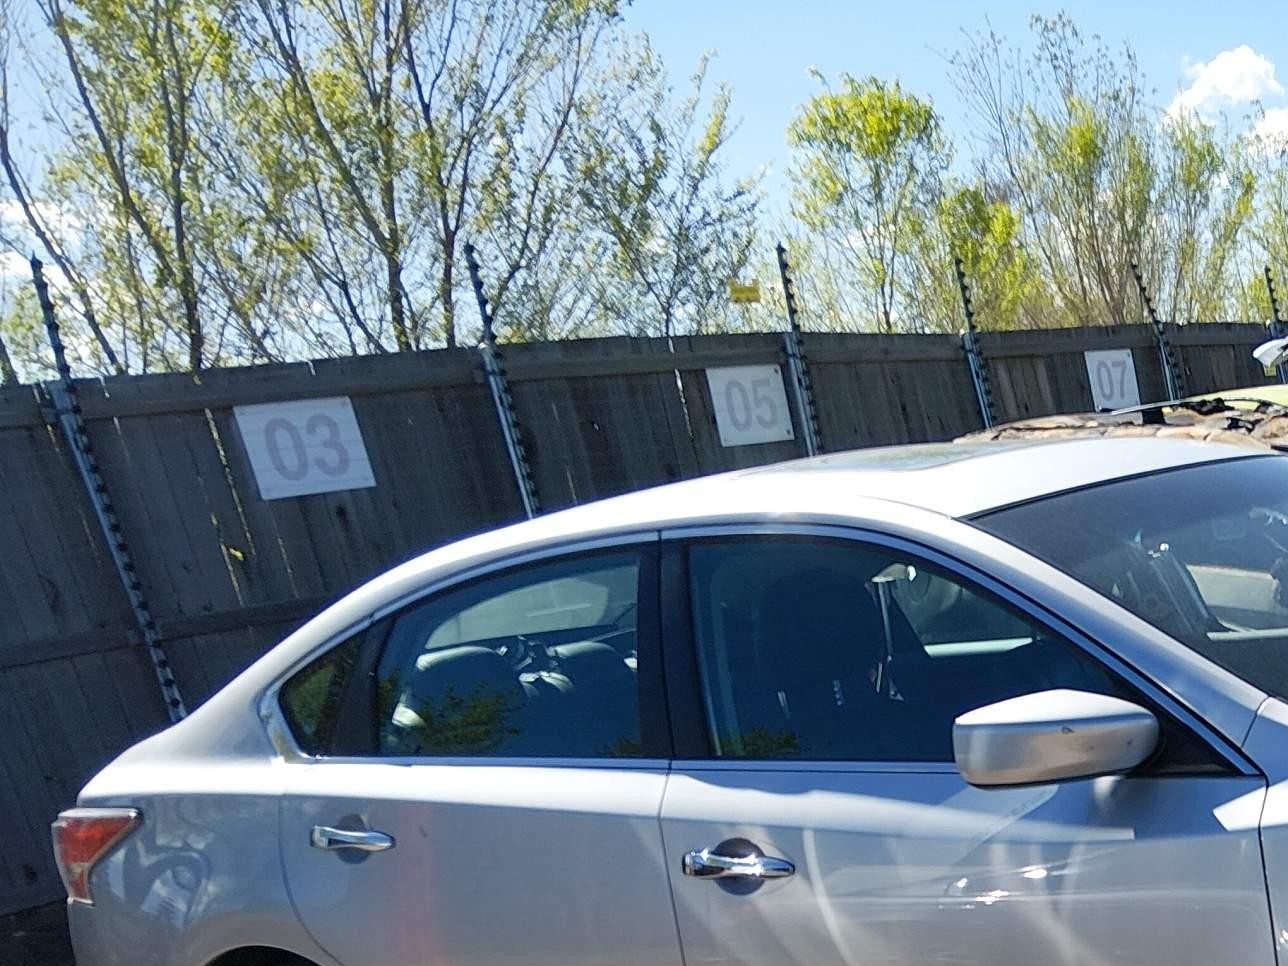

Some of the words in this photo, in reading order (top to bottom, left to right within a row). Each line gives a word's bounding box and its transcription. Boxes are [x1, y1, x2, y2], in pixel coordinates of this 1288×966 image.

[726, 380, 777, 432] 05
[1096, 360, 1126, 401] 07
[264, 414, 349, 481] 03
